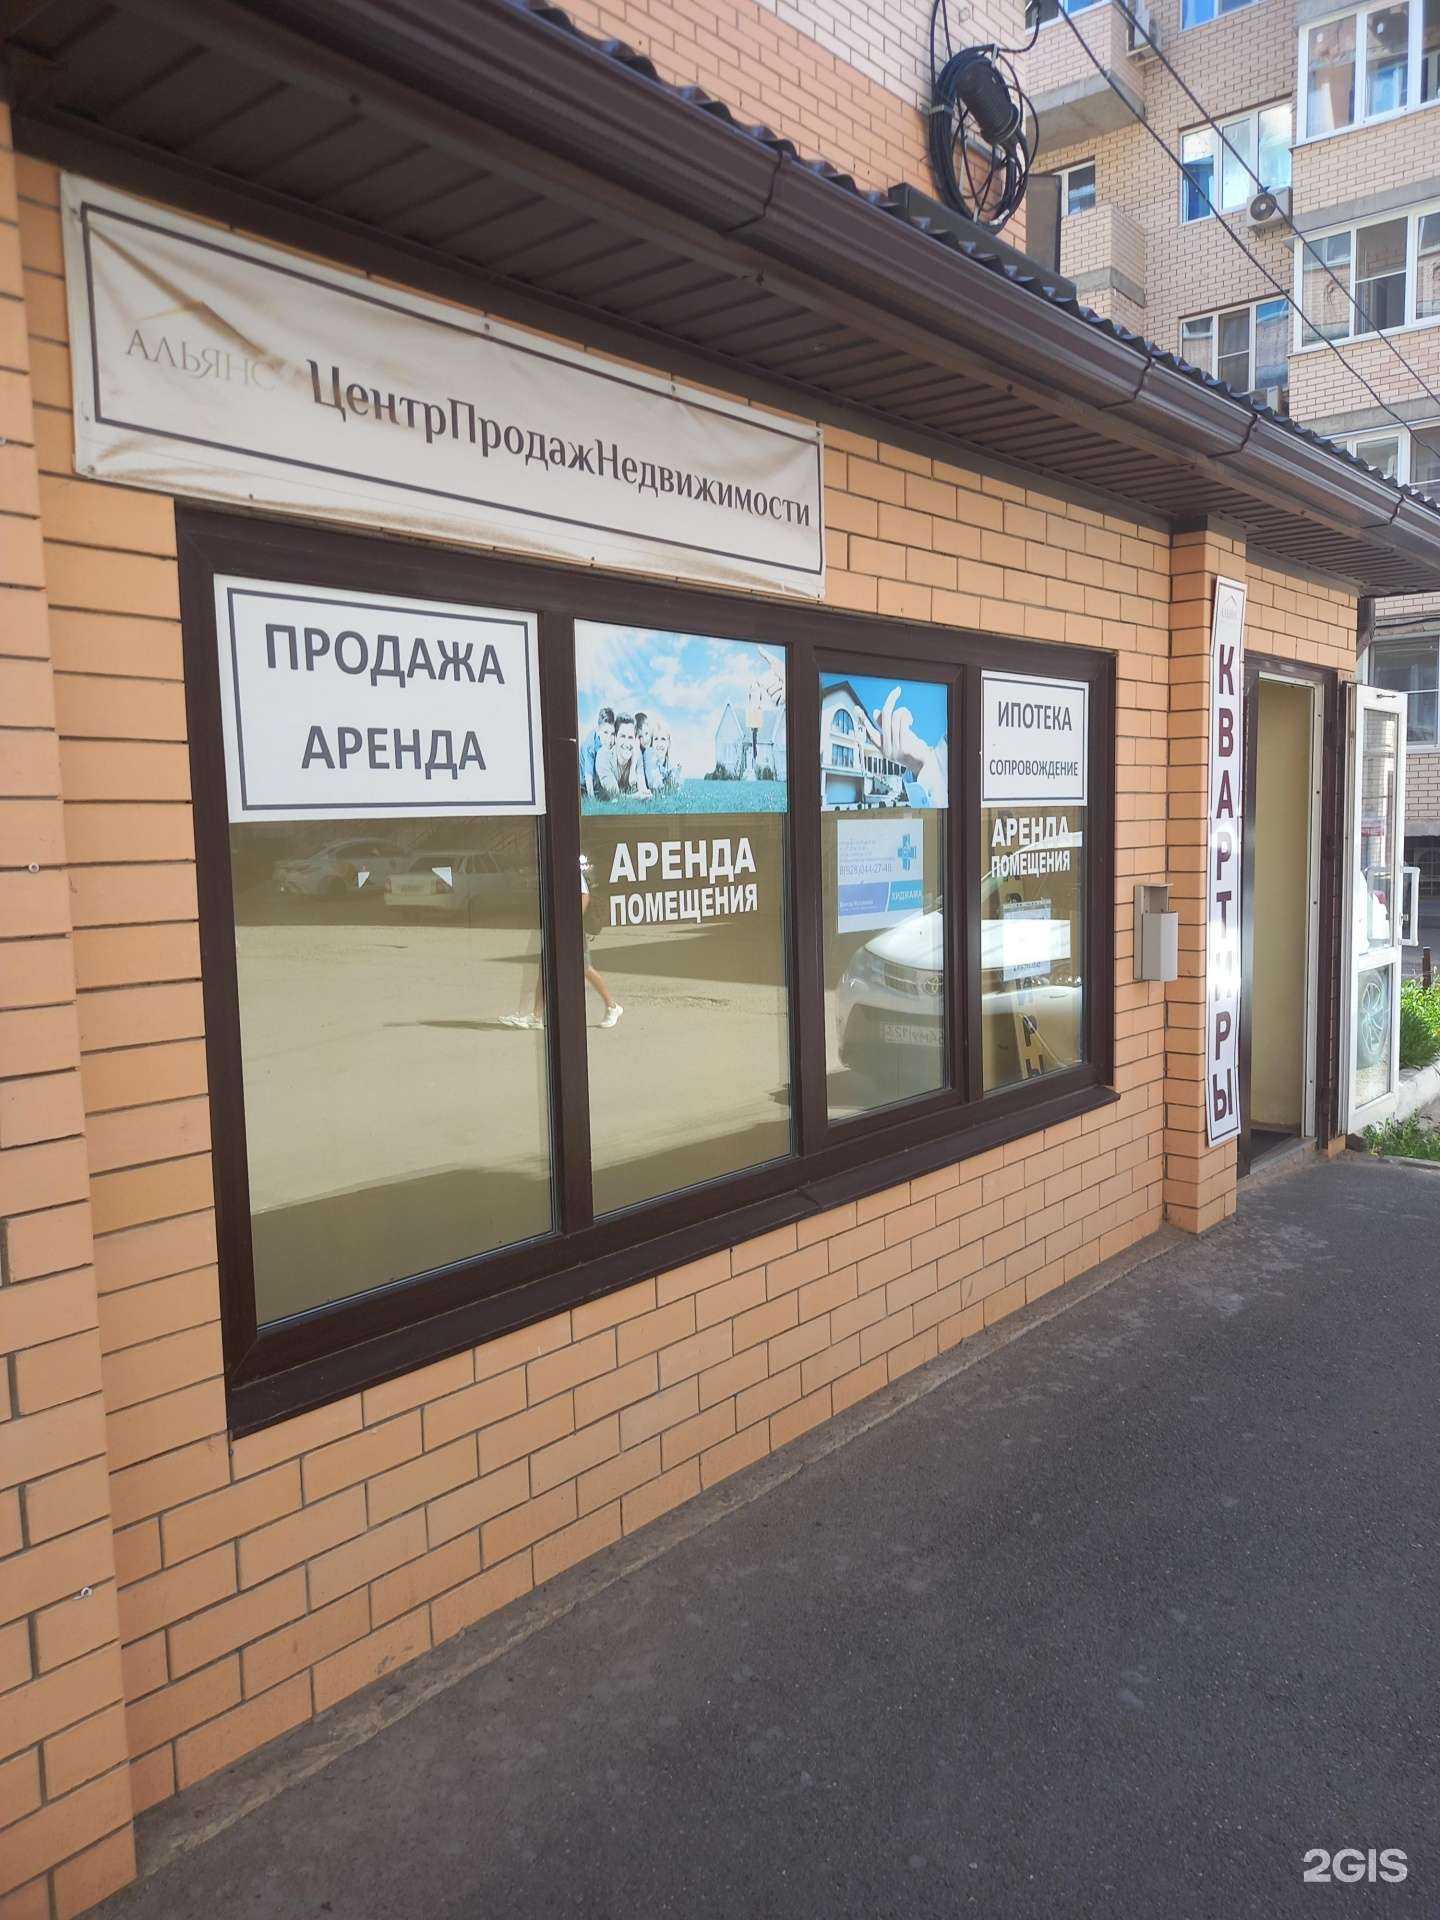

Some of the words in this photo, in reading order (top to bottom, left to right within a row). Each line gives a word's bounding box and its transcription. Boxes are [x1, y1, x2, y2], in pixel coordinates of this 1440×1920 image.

[127, 328, 279, 392] АЛЬЯНС
[264, 623, 506, 689] ПРОДАЖА
[997, 701, 1073, 732] ИПОТЕКА
[300, 725, 487, 780] АРЕНДА
[989, 759, 1079, 780] СОПРОВОЖДЕНИЕ
[991, 815, 1069, 848] АРЕНДА
[608, 836, 757, 885] АРЕНДА
[991, 850, 1071, 878] ПОМЕЩЕНИЯ
[609, 883, 759, 927] ПОМЕЩЕНИЯ
